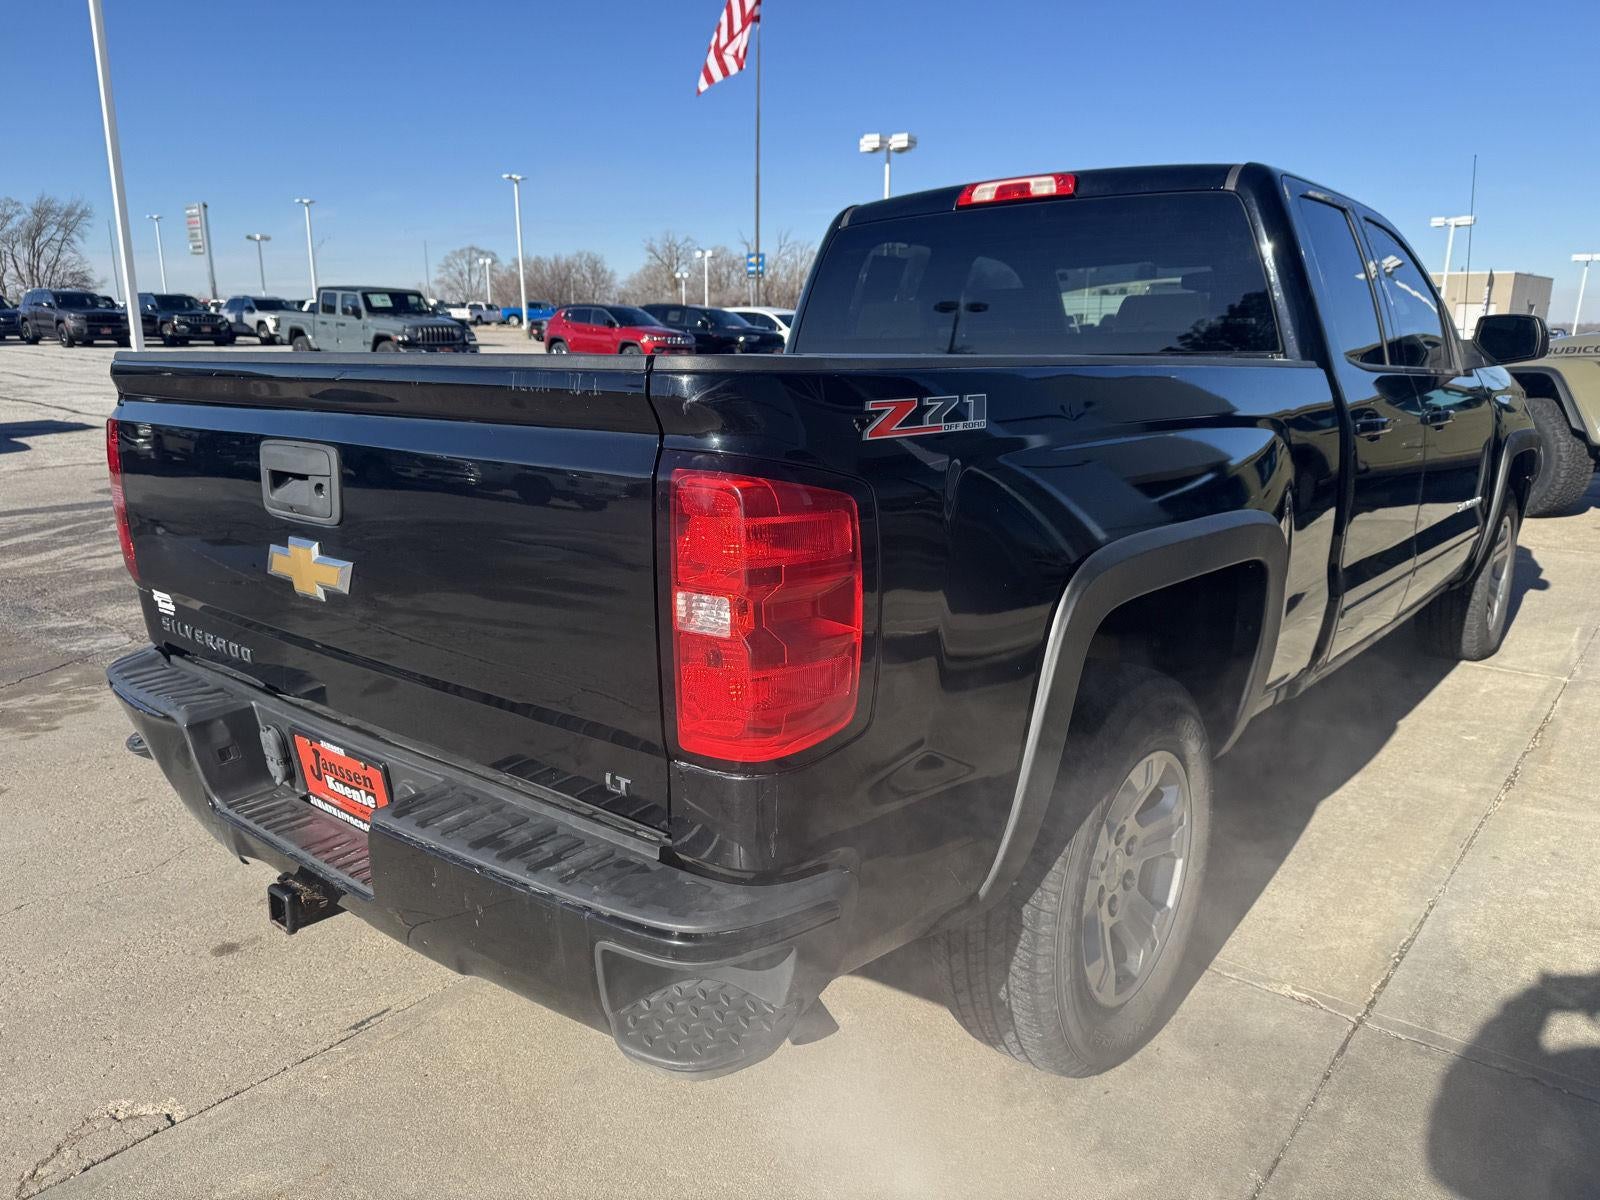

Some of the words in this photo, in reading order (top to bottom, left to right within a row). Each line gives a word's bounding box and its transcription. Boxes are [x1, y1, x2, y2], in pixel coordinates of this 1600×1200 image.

[863, 393, 987, 440] Z71
[943, 421, 960, 431] OFF
[962, 419, 986, 430] ROAD
[161, 615, 252, 664] SILVERADO
[310, 747, 375, 791] Janssen
[605, 772, 632, 798] LT
